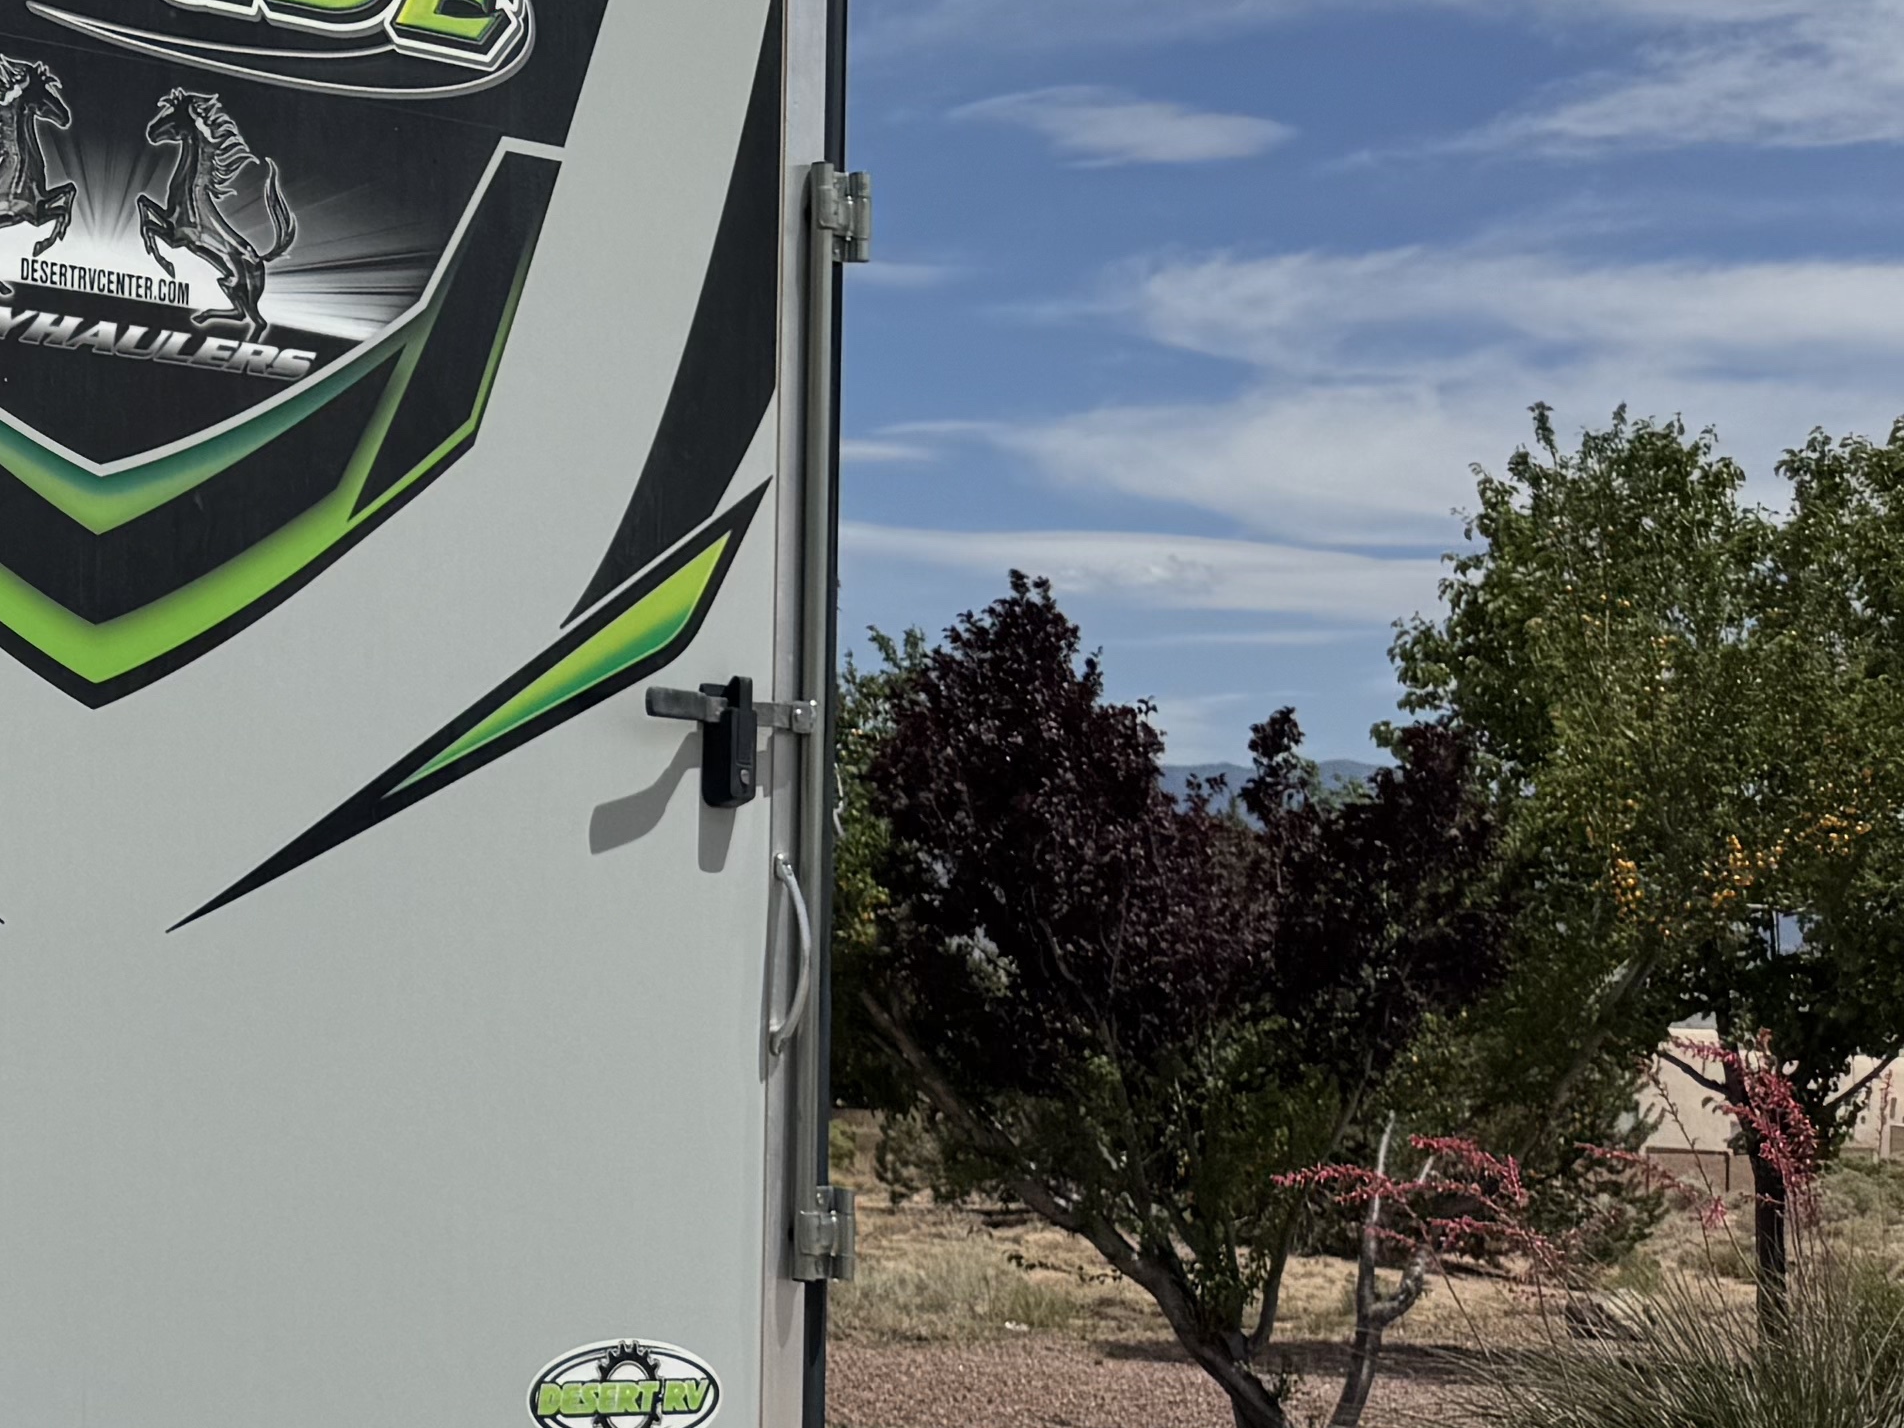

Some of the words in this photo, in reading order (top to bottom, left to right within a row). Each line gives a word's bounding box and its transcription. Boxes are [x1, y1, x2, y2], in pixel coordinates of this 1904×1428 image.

[20, 256, 190, 307] DESERTRVCENTER.COM
[538, 1380, 660, 1417] DESERT
[662, 1378, 711, 1414] RV
